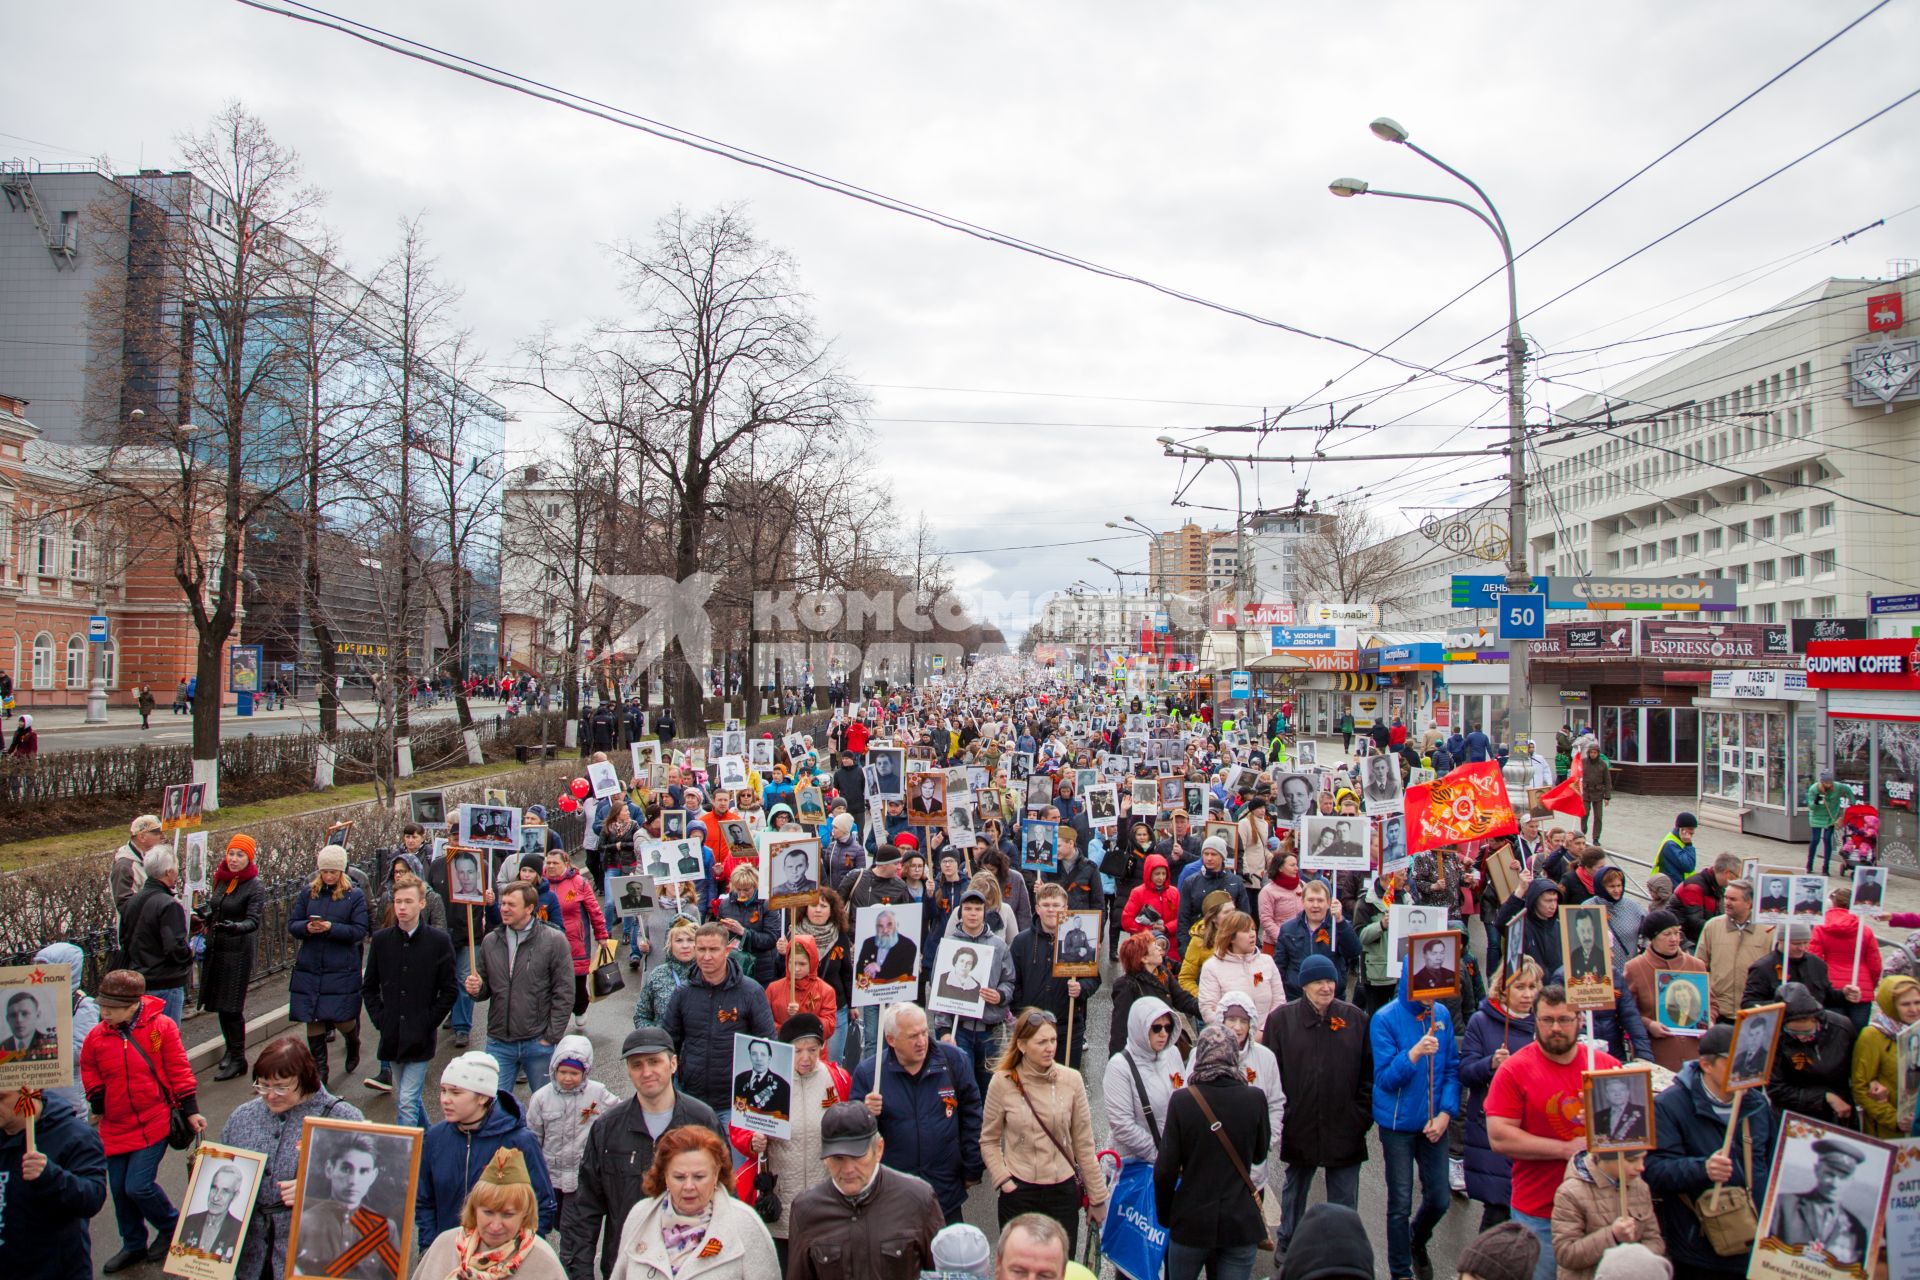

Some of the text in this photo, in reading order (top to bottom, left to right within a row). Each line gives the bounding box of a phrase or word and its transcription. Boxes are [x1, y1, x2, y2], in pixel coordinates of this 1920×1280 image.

[1481, 583, 1511, 592] ДЕНЬ
[1572, 580, 1715, 599] СВЯЗНОЙ
[1244, 607, 1294, 623] АЙМЫ
[1510, 608, 1535, 626] 50
[1726, 642, 1754, 656] BAR
[1806, 656, 1856, 673] GUDMEN
[1859, 656, 1902, 673] COFFEE
[1748, 672, 1775, 683] ГАЗЕТЫ
[1735, 686, 1765, 696] ЖУРНАЛЫ
[44, 975, 66, 983] ПОЛК
[1791, 1259, 1832, 1279] ПАКЛИН
